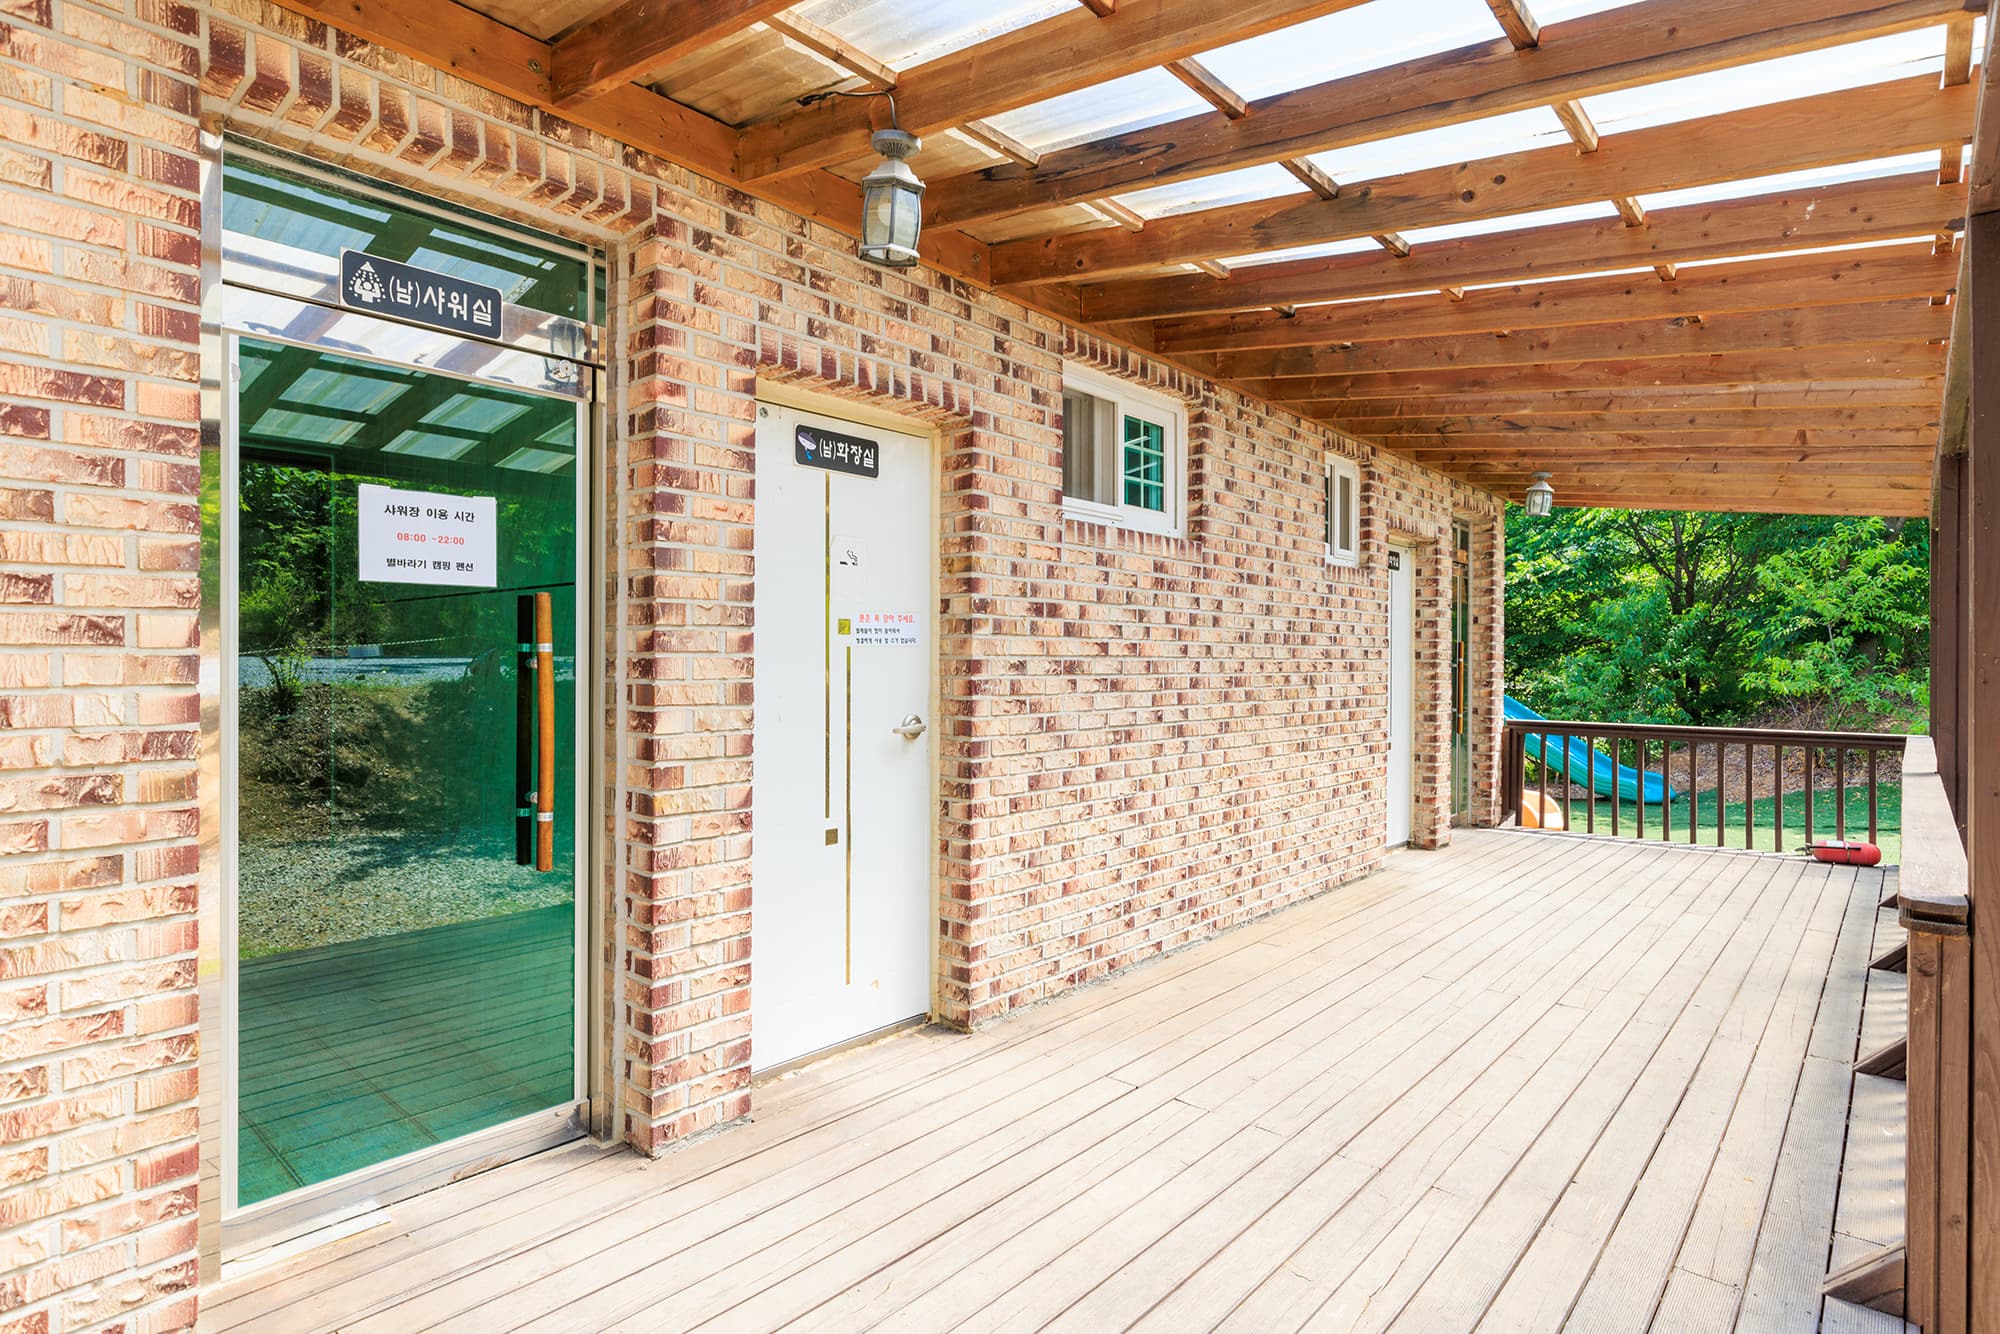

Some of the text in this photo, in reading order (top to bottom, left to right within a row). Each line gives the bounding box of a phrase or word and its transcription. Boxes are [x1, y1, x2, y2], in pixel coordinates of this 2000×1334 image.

[389, 275, 492, 327] (남)샤워실
[819, 438, 875, 469] (남)화장실
[384, 504, 475, 523] 샤워장 이용 시간
[396, 532, 465, 546] 08:00 ~22:00
[386, 558, 474, 573] 별바라기 캠핑 펜션
